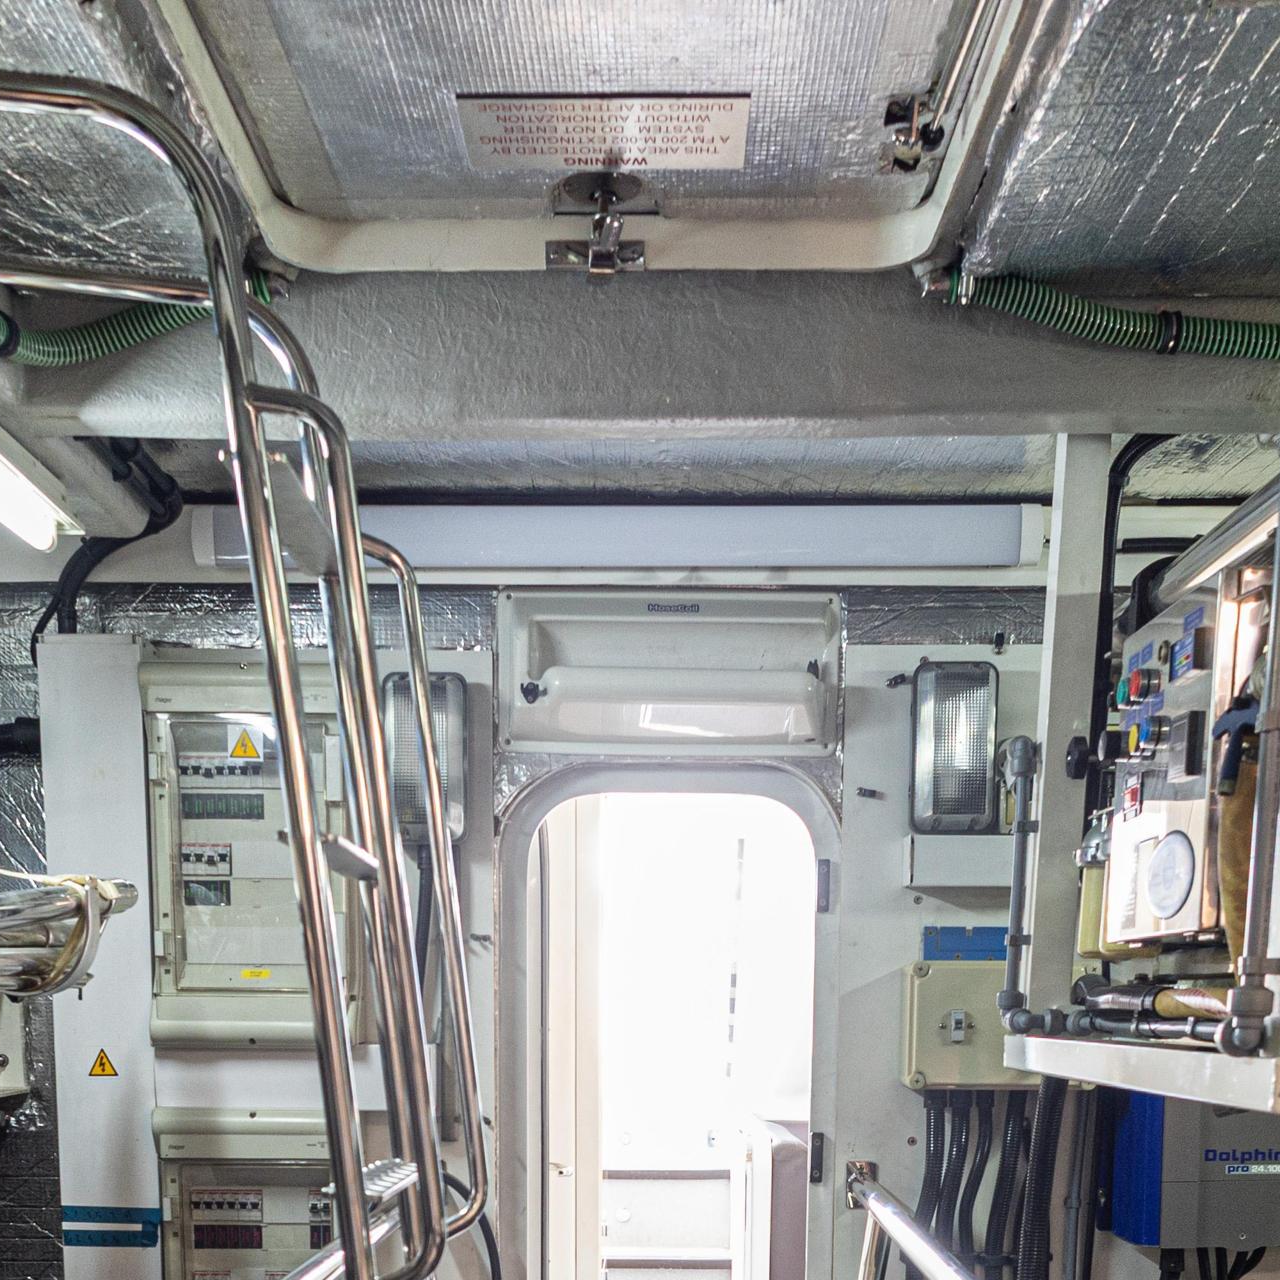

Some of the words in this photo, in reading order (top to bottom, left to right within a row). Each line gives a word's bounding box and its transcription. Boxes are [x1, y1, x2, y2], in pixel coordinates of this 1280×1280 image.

[669, 103, 734, 111] DURING
[496, 115, 629, 123] AUTHORIZATION
[480, 136, 607, 145] EXTINGUISHING
[662, 136, 687, 144] 200
[692, 136, 715, 144] FM
[720, 136, 730, 144] A
[564, 158, 648, 166] WARNING
[1227, 1163, 1249, 1174] pro
